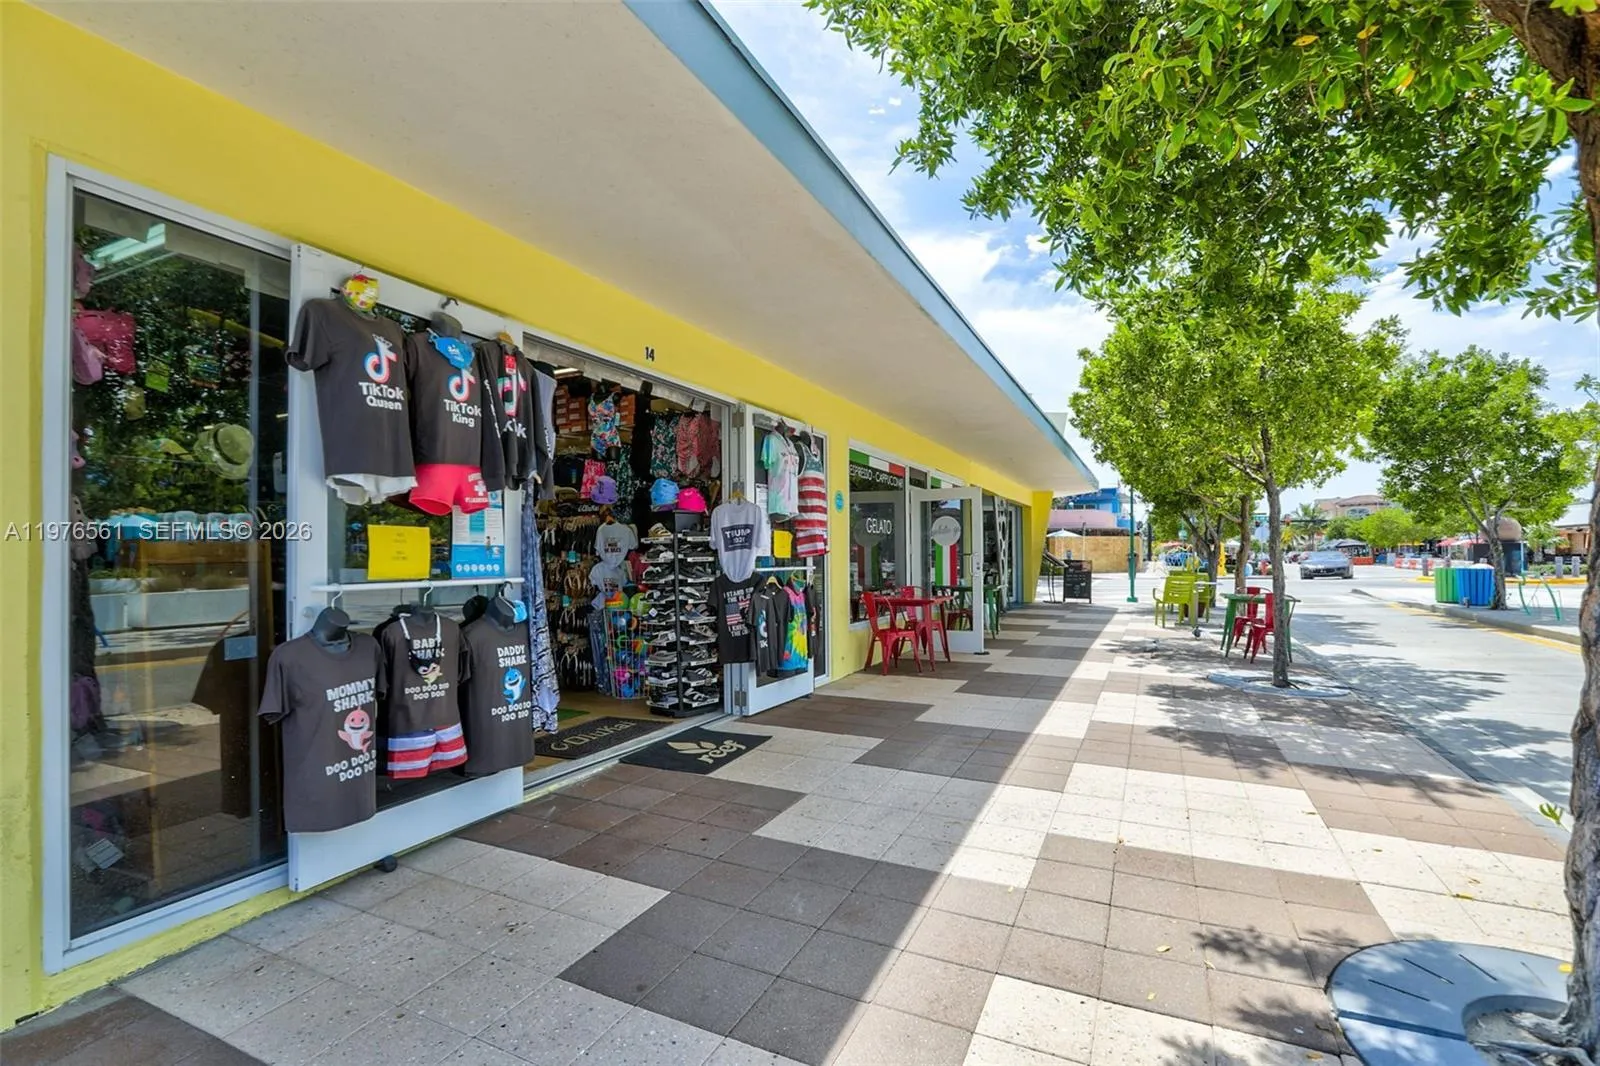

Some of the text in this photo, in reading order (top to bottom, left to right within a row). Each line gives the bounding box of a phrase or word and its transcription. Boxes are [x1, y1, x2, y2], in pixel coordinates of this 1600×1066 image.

[645, 346, 655, 362] 14
[358, 381, 405, 400] TikTok
[366, 395, 402, 411] Queen
[443, 399, 482, 417] TikTok
[452, 412, 475, 428] King
[865, 517, 892, 534] GELATO
[413, 638, 442, 649] BABY
[497, 645, 526, 657] DADDY
[498, 655, 527, 668] SHARK
[326, 677, 375, 701] MOMMY
[404, 686, 421, 694] DOO
[422, 684, 438, 692] DOO
[413, 690, 445, 700] DOO DOO
[333, 691, 374, 712] SHARK
[491, 706, 507, 715] DOO
[501, 713, 516, 722] DOO
[697, 740, 747, 764] reef
[326, 760, 348, 776] DOO
[351, 753, 370, 767] DOO
[339, 766, 362, 782] DOO
